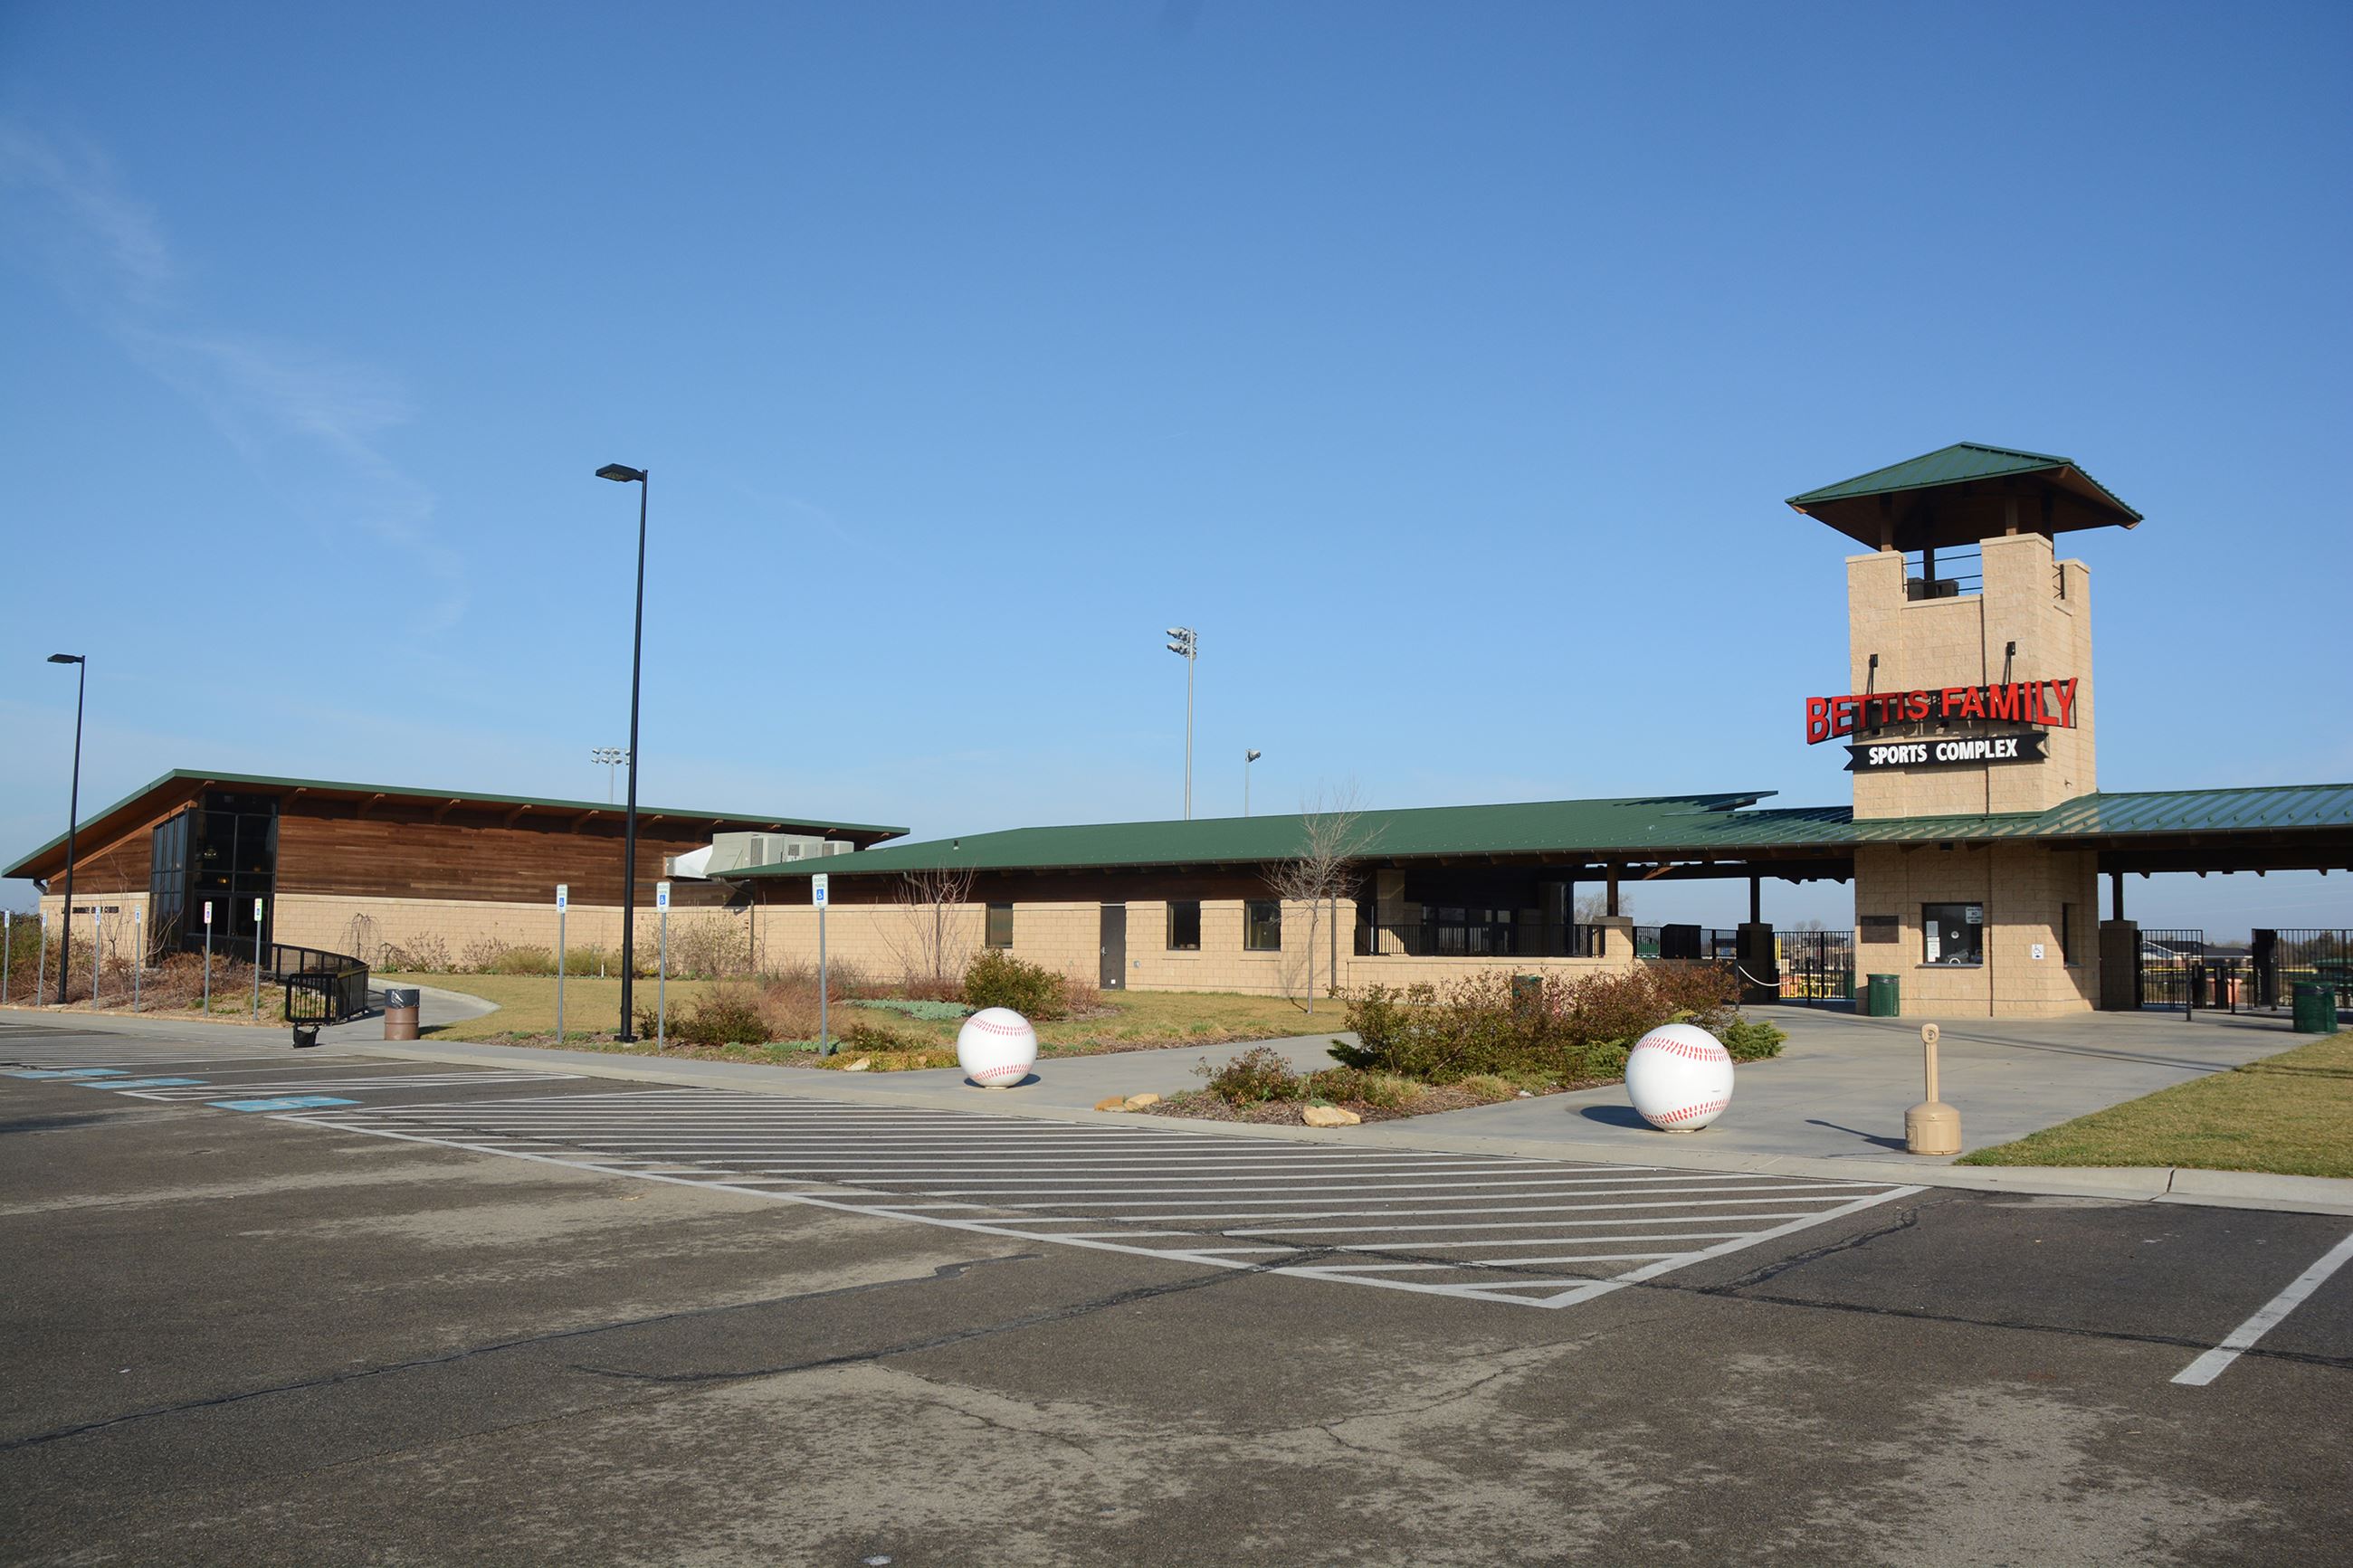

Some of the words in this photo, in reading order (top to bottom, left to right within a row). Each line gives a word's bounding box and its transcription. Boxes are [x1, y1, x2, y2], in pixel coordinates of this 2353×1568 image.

[1806, 689, 1929, 745] BETTIS
[1941, 677, 2078, 728] FAMILY
[1869, 744, 1928, 765] SPORTS
[1936, 739, 2018, 762] COMPLEX
